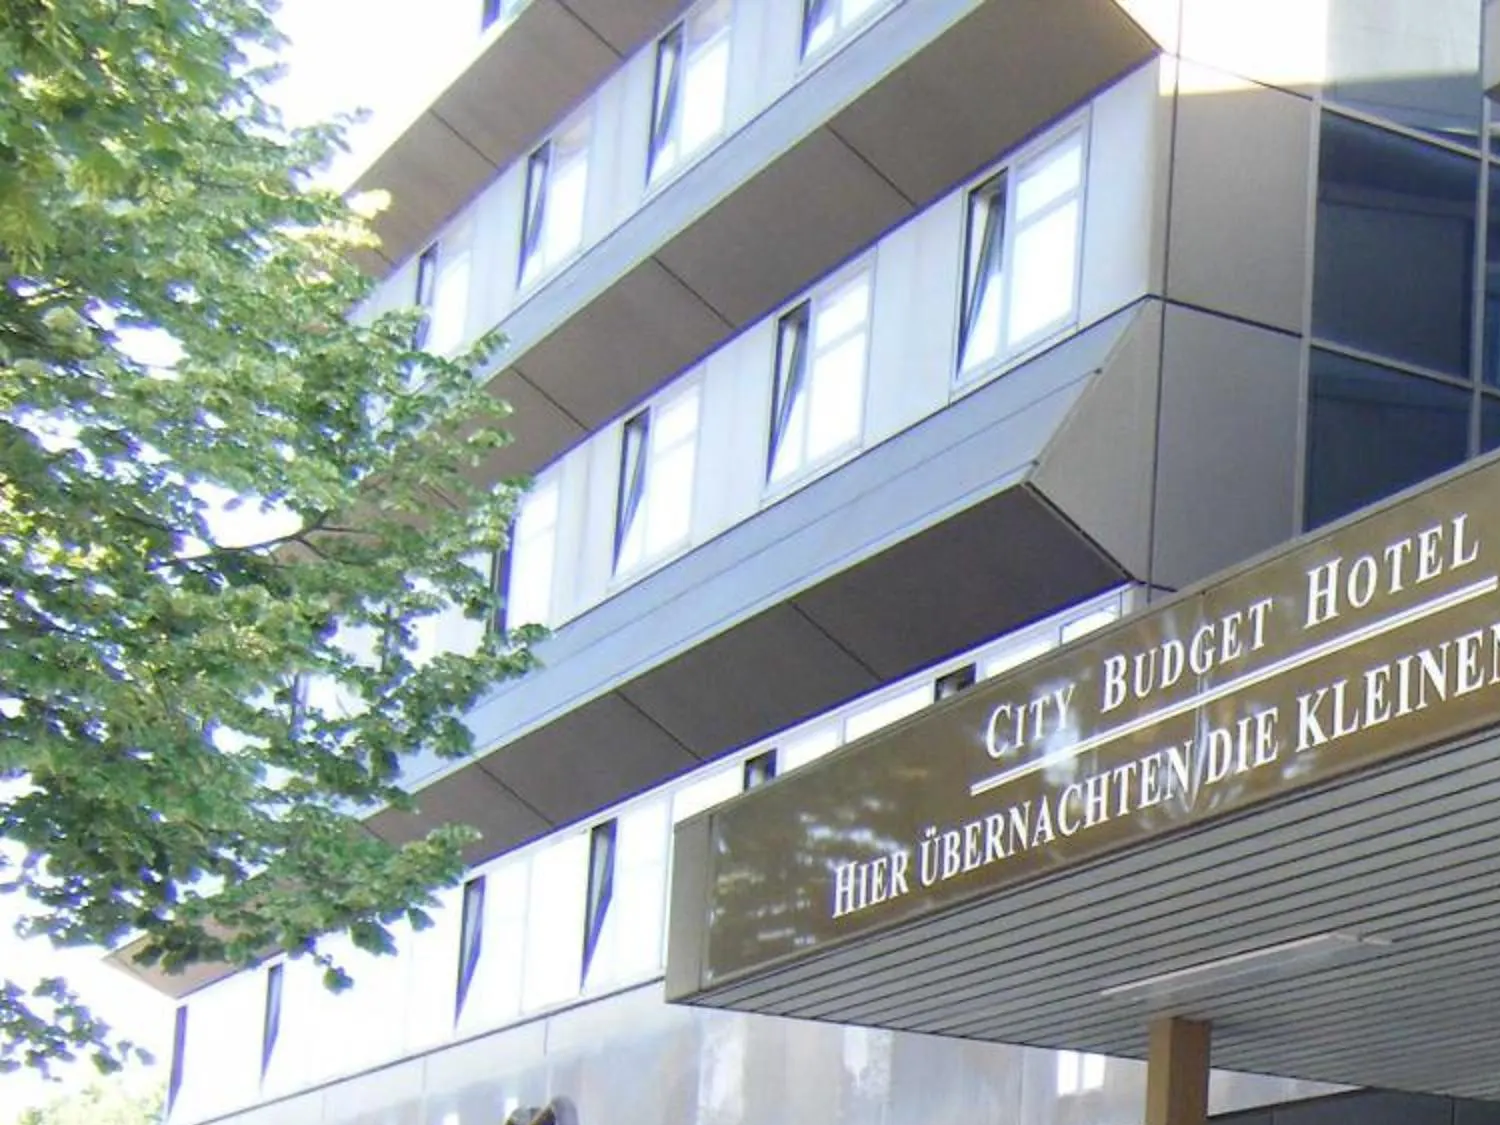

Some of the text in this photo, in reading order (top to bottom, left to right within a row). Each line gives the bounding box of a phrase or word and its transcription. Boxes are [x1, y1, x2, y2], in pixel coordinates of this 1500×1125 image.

[985, 513, 1480, 760] CITY BUDGET HOTEL
[831, 848, 910, 919] HIER
[919, 739, 1193, 887] ÜBERNACHTEN
[1203, 706, 1280, 786] DIE
